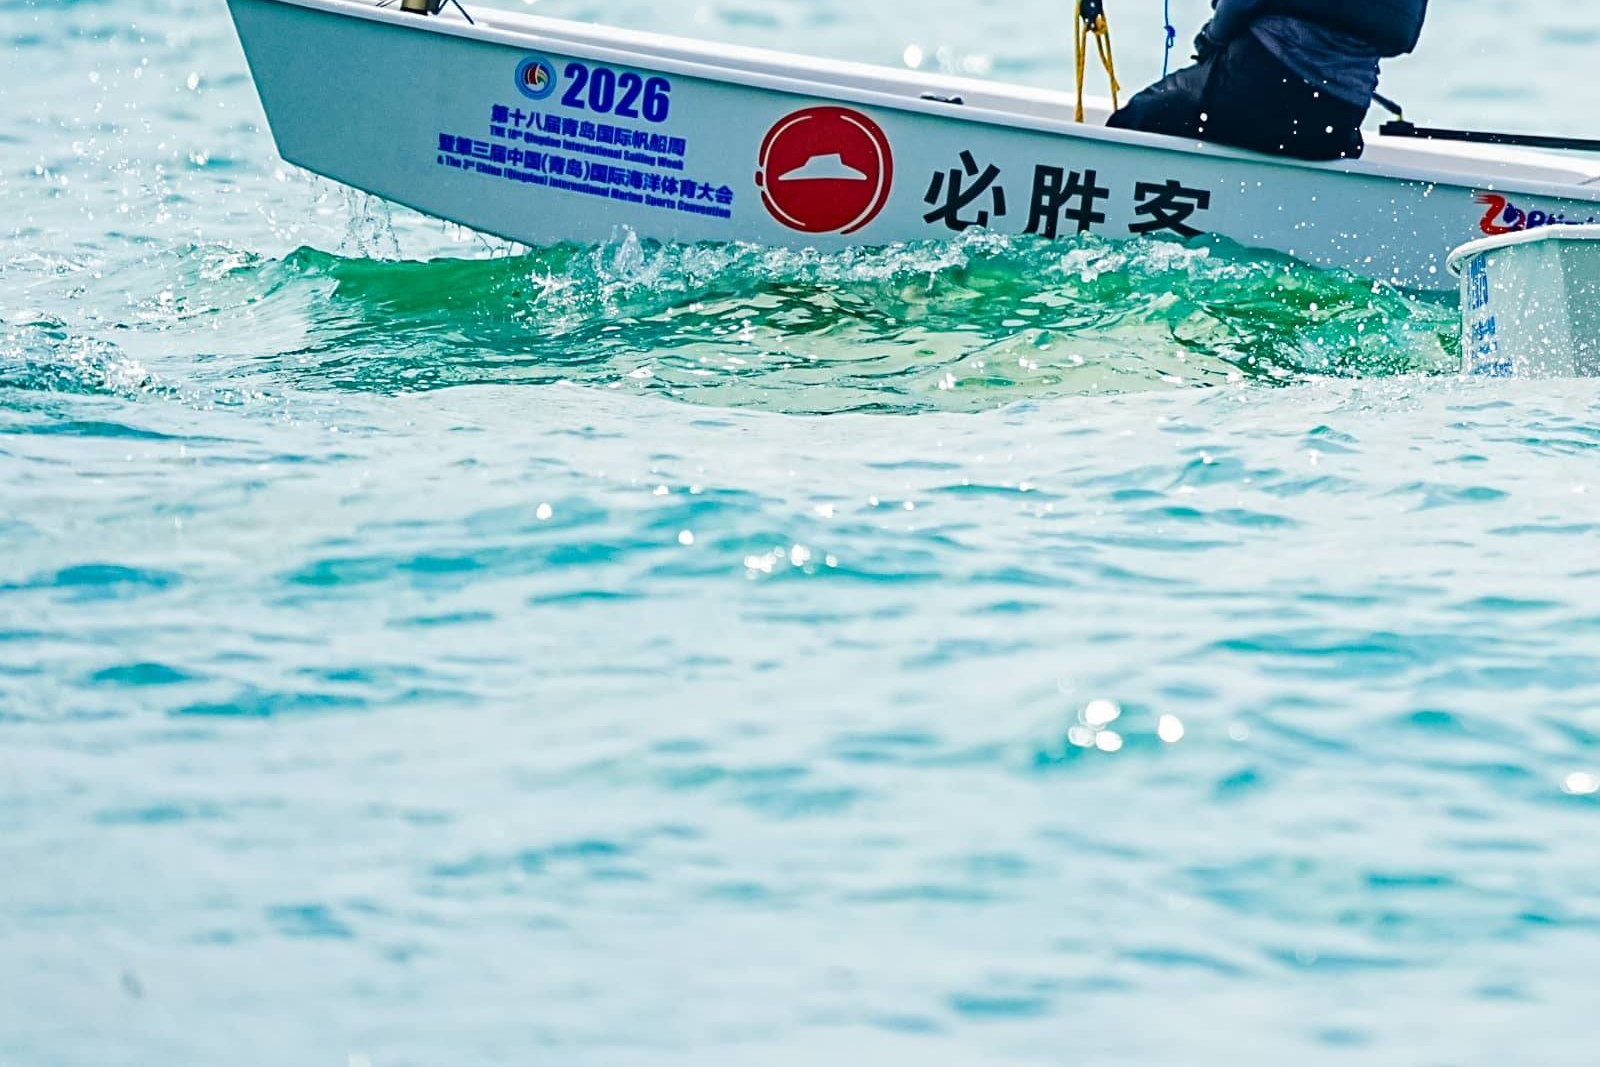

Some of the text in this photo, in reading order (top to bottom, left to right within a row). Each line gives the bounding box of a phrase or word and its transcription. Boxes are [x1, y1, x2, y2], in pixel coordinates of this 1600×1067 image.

[560, 62, 672, 124] 2026
[490, 103, 687, 157] 第十八届青岛国际帆船周
[562, 139, 623, 160] International
[922, 149, 1212, 240] 必胜客
